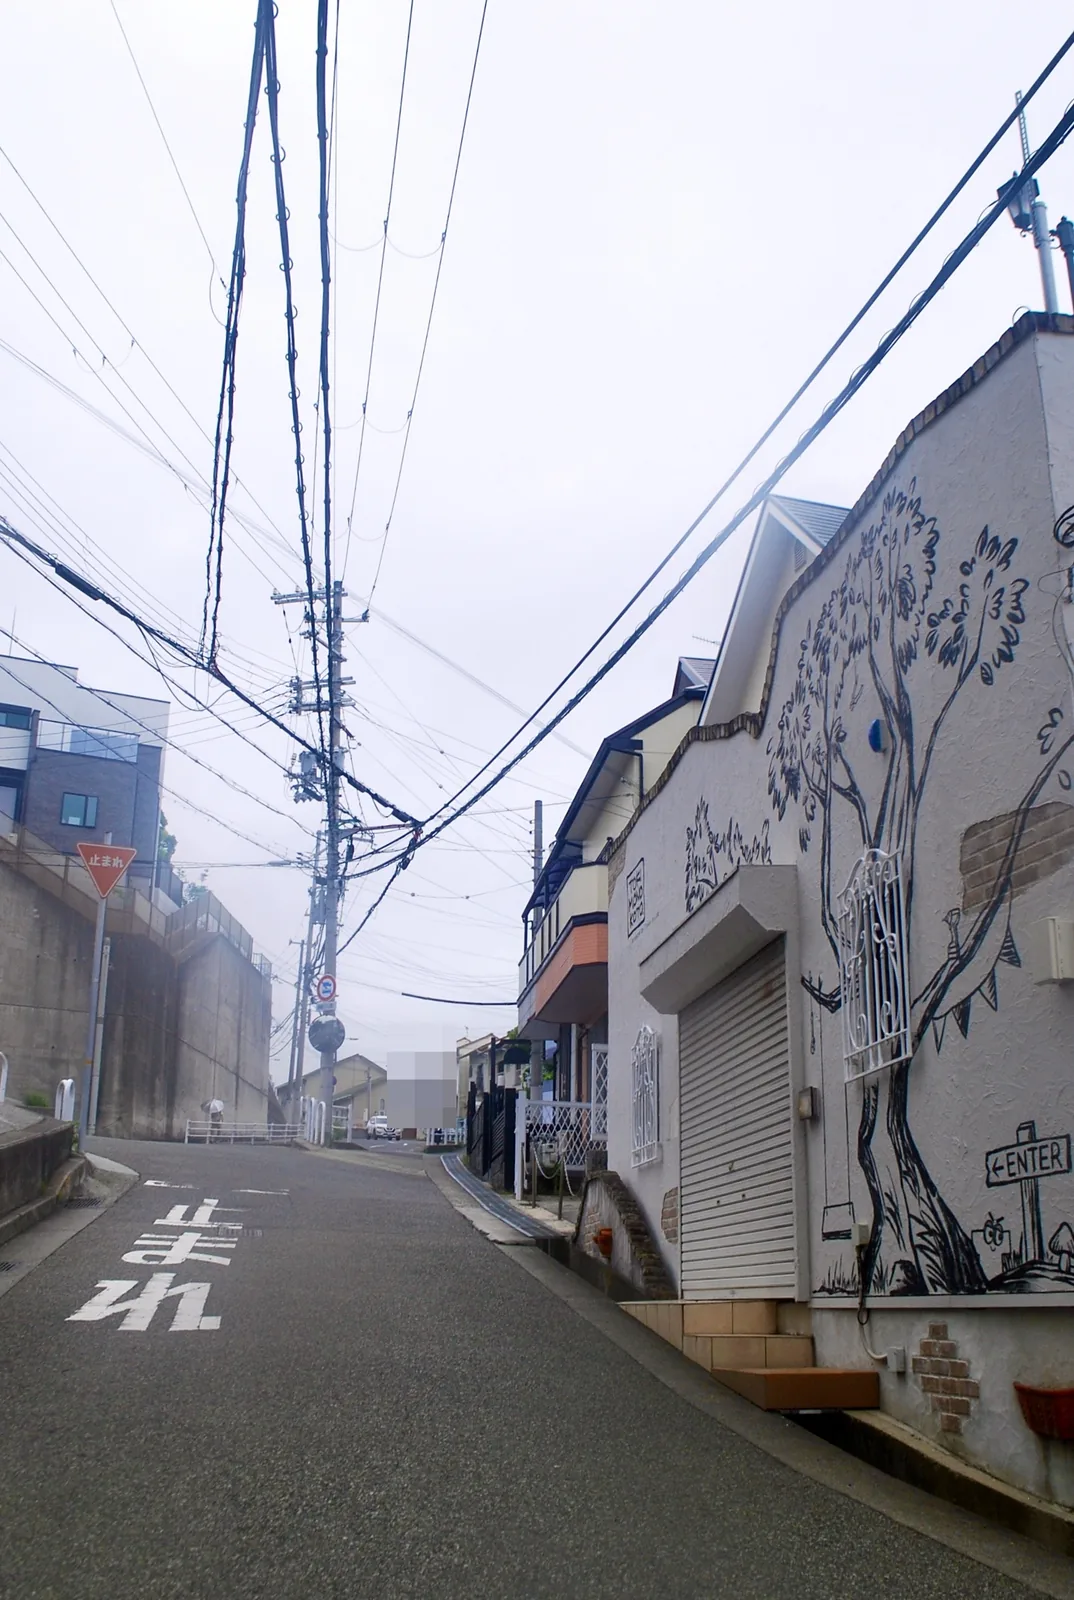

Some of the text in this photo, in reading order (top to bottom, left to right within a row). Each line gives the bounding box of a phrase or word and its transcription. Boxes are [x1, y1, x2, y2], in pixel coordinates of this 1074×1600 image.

[88, 854, 124, 868] 止まれ
[1006, 1141, 1063, 1178] ENTER
[64, 1199, 248, 1331] 止まれ
